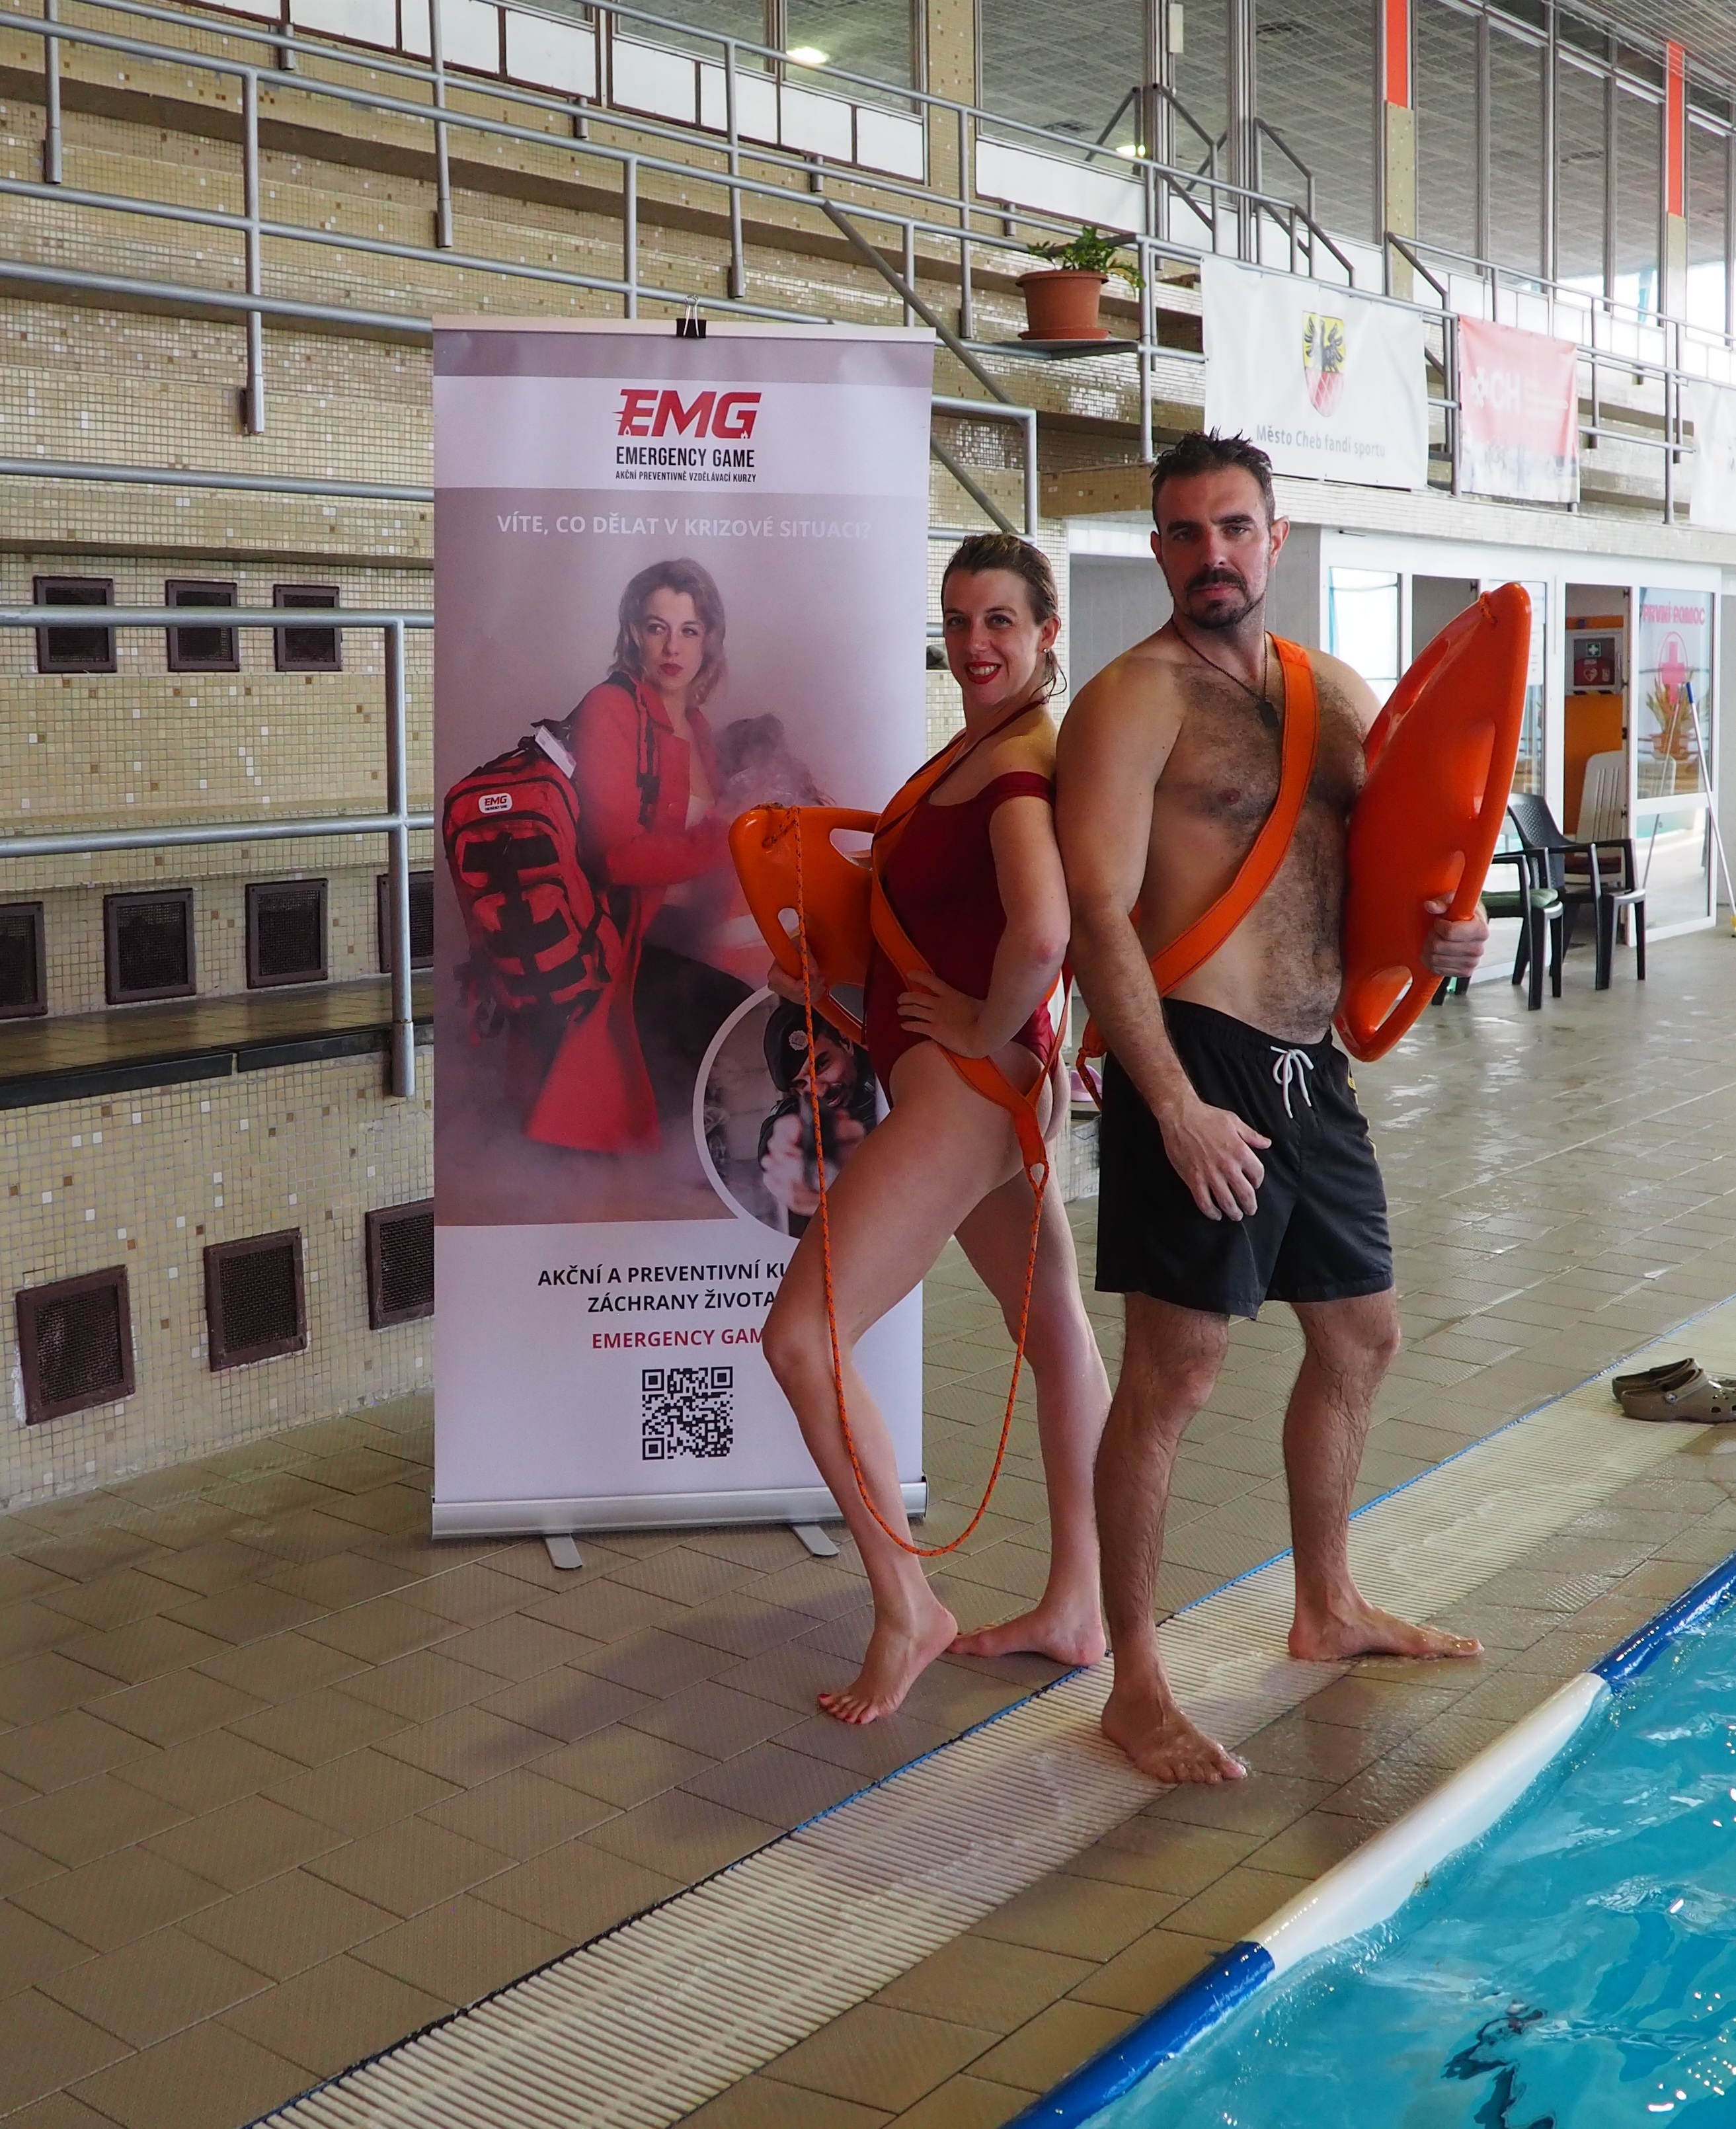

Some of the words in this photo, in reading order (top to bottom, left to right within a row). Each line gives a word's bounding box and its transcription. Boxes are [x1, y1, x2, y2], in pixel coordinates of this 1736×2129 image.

[613, 389, 762, 439] EMG
[1256, 424, 1292, 446] Město
[1296, 430, 1322, 450] Cheb
[1355, 441, 1386, 460] sportu
[616, 446, 707, 466] EMERGENCY
[713, 449, 755, 467] GAME
[615, 469, 637, 480] AKČNÍ
[639, 470, 687, 481] PREVENTIVNĚ
[689, 471, 731, 482] VZDĚLÁVACÍ
[732, 473, 756, 483] KURZY
[497, 511, 549, 535] VÍTE,
[556, 516, 586, 533] CO
[593, 512, 659, 534] DĚLAT
[664, 518, 679, 535] V
[685, 516, 774, 537] KRIZOVÉ
[779, 520, 871, 538] SITUACI?
[1673, 605, 1706, 625] POMOC
[485, 795, 508, 806] EMG
[537, 1264, 603, 1286] AKČNÍ
[608, 1267, 621, 1283] A
[628, 1259, 761, 1283] PREVENTIVNÍ
[588, 1292, 699, 1312] ZÁCHRANY
[704, 1289, 775, 1309] ŽIVOTA
[592, 1329, 715, 1349] EMERGENCY
[721, 1327, 764, 1345] GAM
